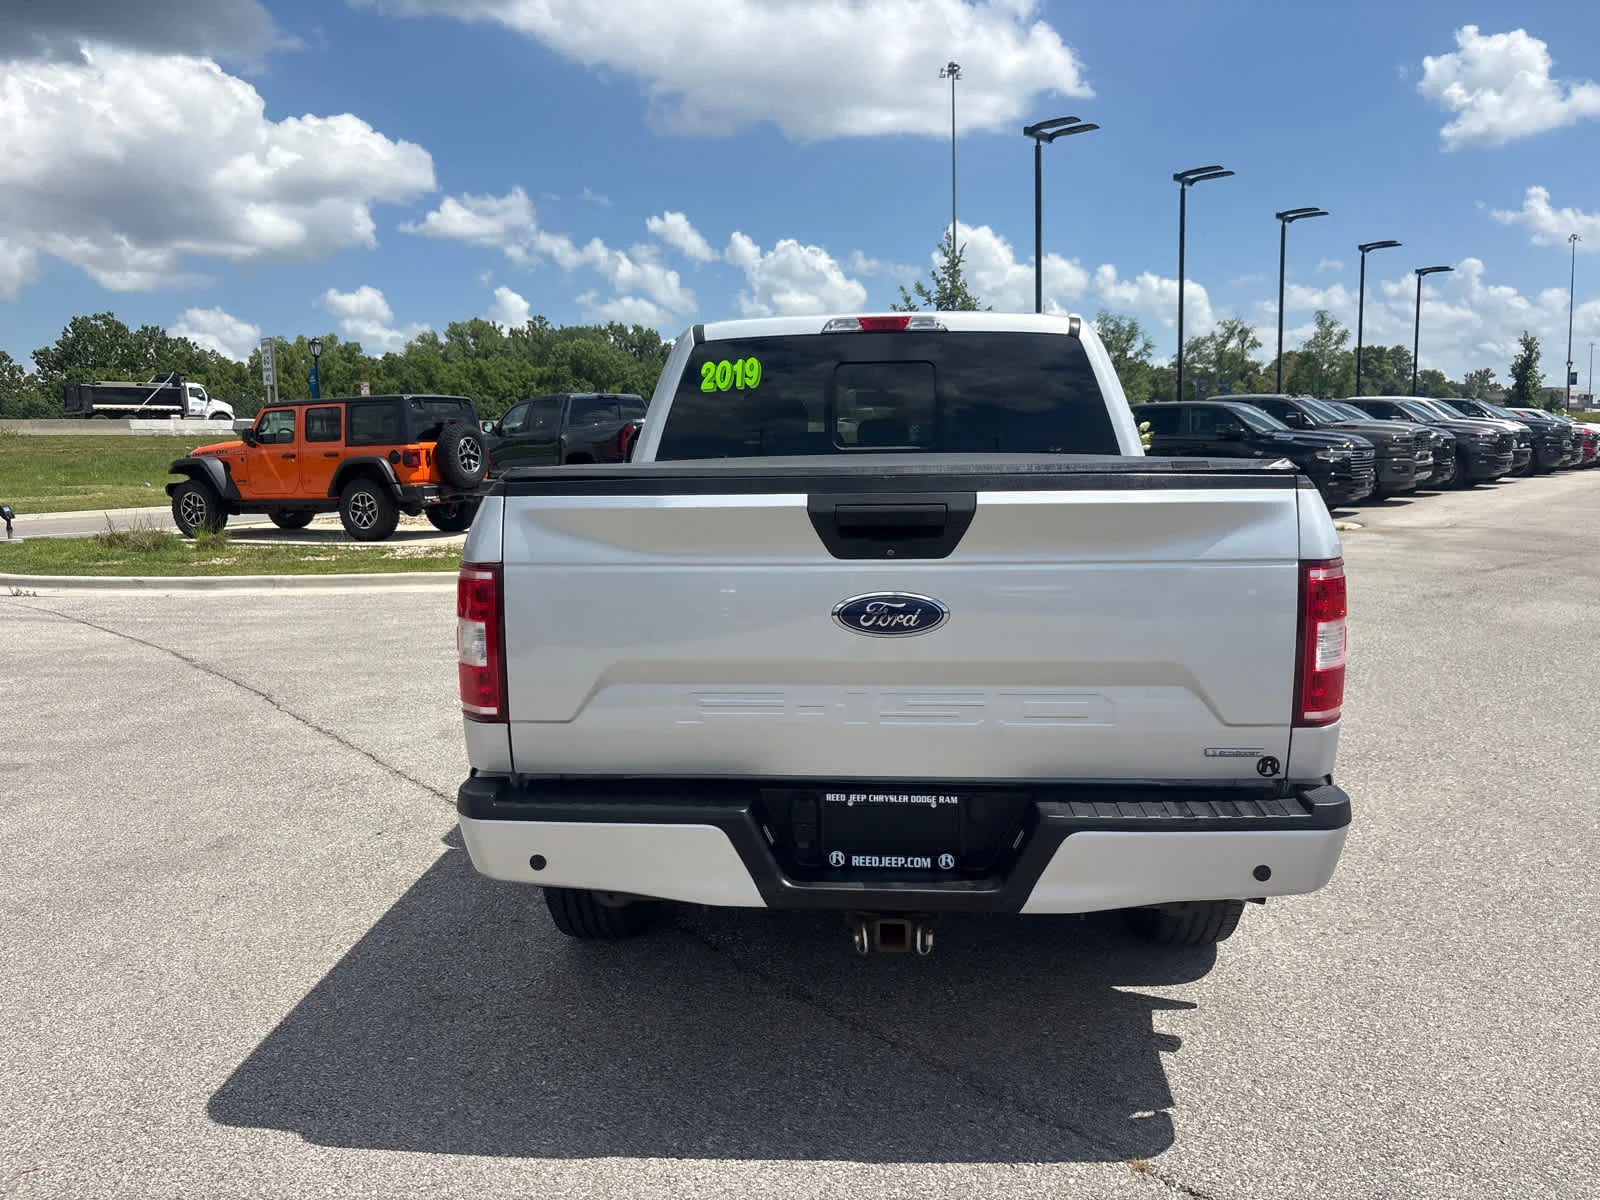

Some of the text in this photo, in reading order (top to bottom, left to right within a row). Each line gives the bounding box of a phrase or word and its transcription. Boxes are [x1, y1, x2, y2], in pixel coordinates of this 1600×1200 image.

[701, 357, 762, 392] 2019
[859, 601, 922, 627] Ford
[826, 793, 958, 805] REED JEEP CHRYSLER DODGE RAM
[851, 855, 932, 869] REEDJEEP.COM
